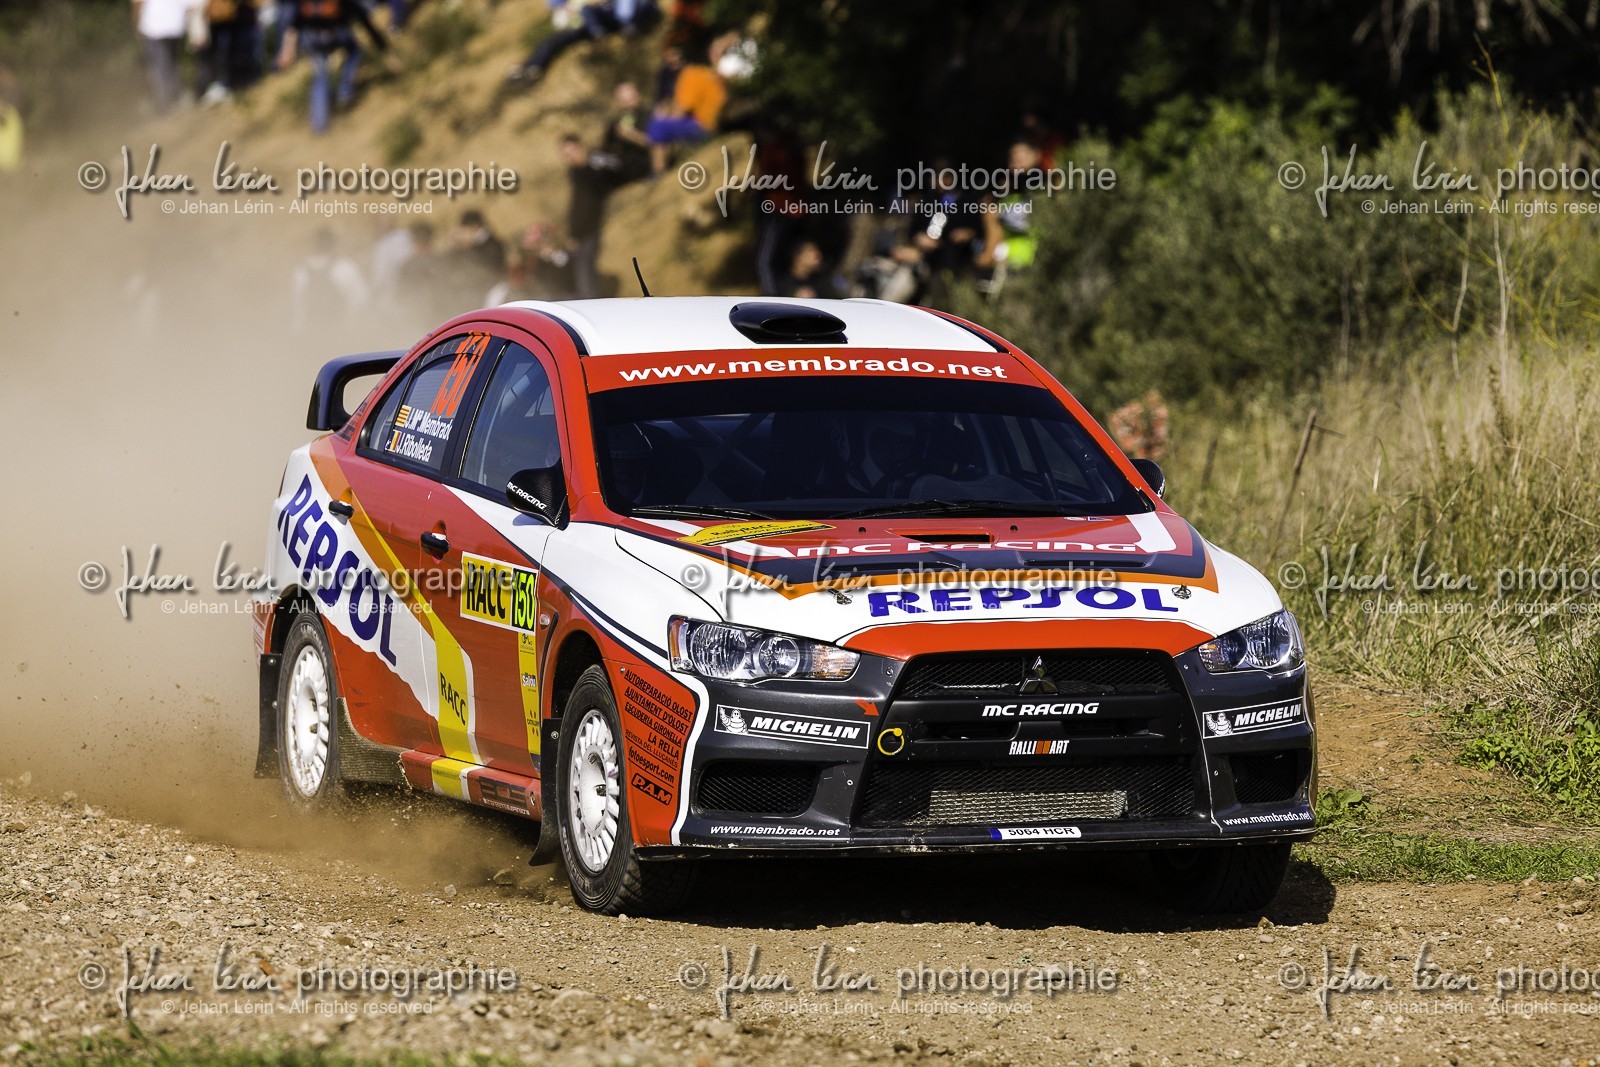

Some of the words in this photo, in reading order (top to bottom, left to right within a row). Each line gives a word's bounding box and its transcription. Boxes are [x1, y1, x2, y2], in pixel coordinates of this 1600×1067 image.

[619, 355, 1007, 382] www.membrado.net
[515, 488, 547, 510] RACING
[906, 541, 1136, 553] RACING
[277, 473, 397, 667] REPSOL
[466, 561, 506, 620] RACC
[512, 570, 535, 630] 150
[868, 587, 1179, 618] REPSOL
[440, 671, 467, 726] RACC
[624, 669, 672, 708] AUTOREPARACIÓ
[671, 702, 693, 721] OLOST
[1019, 702, 1100, 716] RACING
[624, 686, 663, 717] AJUNTAMENT
[662, 711, 689, 736] D'OLOST
[625, 701, 653, 727] ESCUDERIA
[653, 721, 682, 748] GIRONELLA
[1234, 703, 1302, 727] MICHELIN
[625, 728, 643, 747] REVISTA
[643, 740, 653, 753] DEL
[751, 716, 860, 739] MICHELIN
[647, 731, 657, 746] LA
[658, 738, 679, 761] RELLA
[628, 745, 675, 784] fotoesport.com
[710, 825, 841, 836] www.membrado.net
[1008, 828, 1041, 836] 5064
[1043, 827, 1076, 835] HCR
[1222, 811, 1313, 826] www.membrado.net
